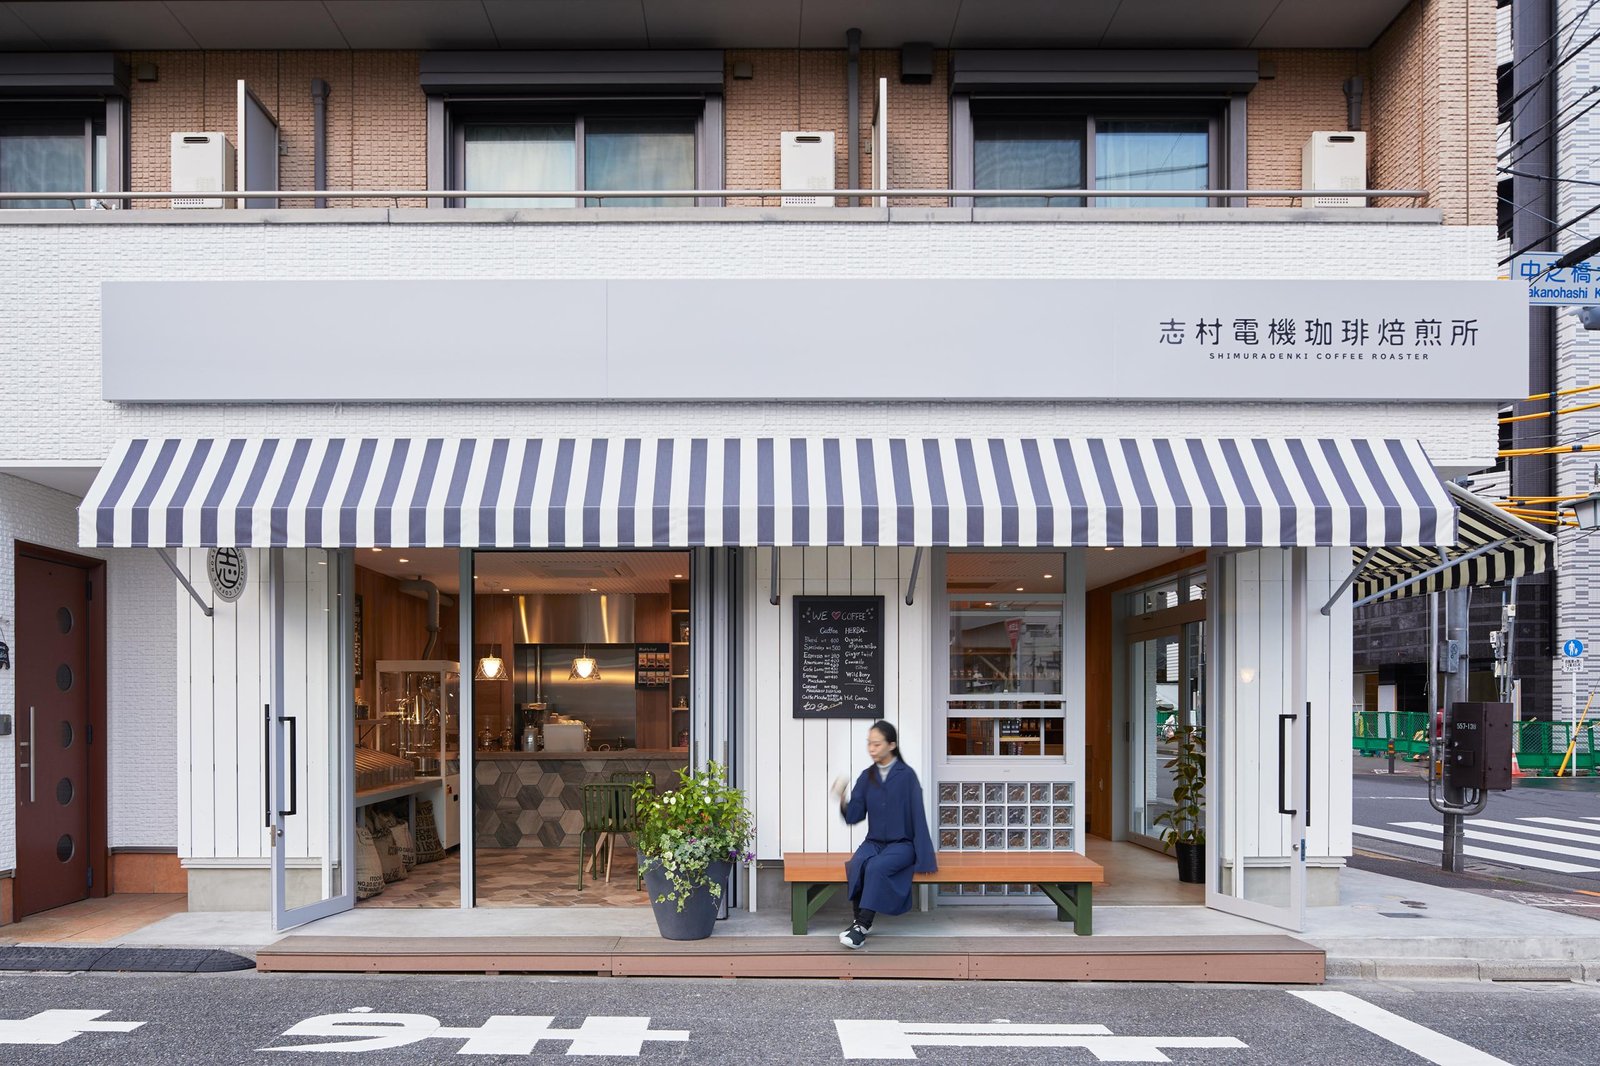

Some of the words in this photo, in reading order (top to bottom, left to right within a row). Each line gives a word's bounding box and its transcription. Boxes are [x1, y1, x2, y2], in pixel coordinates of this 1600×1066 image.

[1520, 260, 1600, 284] 中之橋
[1529, 286, 1588, 299] akanohashi
[1159, 318, 1479, 346] 志村電機珈琲焙煎所
[1209, 352, 1309, 360] SHIMURADENKI
[1316, 352, 1364, 360] COFFEE
[1371, 352, 1430, 360] ROASTER
[812, 611, 828, 621] WE
[841, 611, 866, 621] COFFEE
